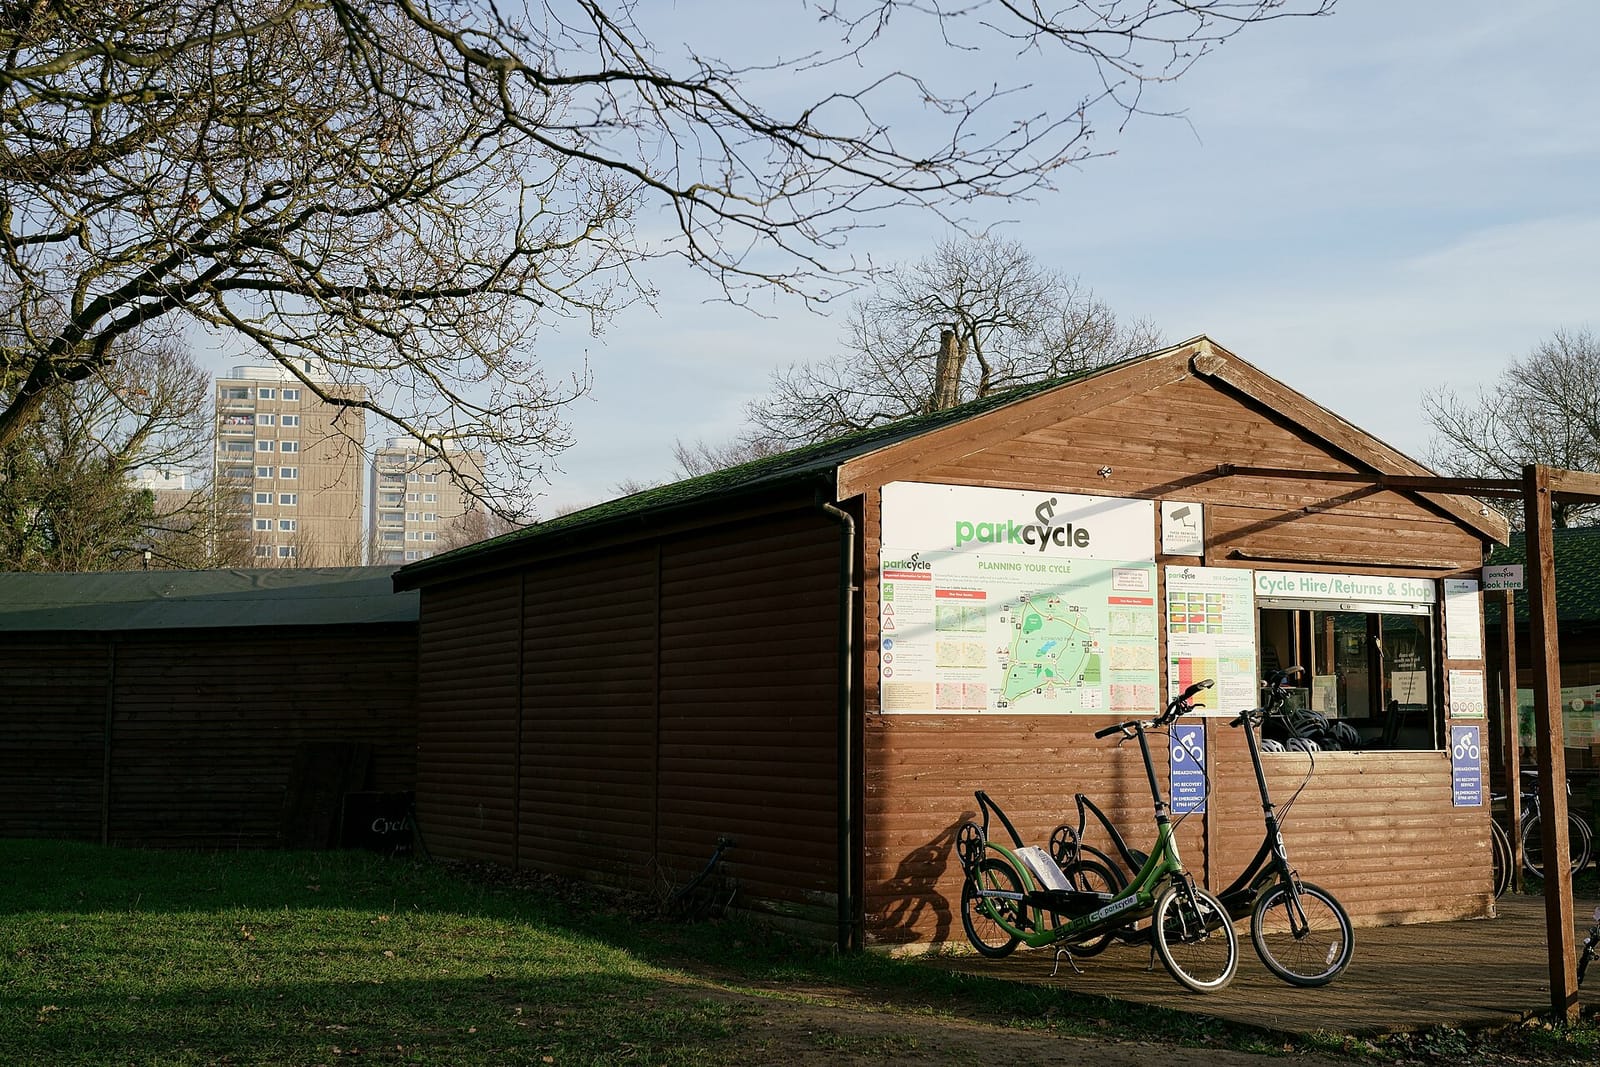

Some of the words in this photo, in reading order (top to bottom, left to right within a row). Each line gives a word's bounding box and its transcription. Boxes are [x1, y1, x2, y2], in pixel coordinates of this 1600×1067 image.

[955, 519, 1090, 552] parkcycle
[883, 559, 931, 571] parkcycle
[978, 561, 1022, 572] PLANNING
[1024, 563, 1047, 573] YOUR
[1048, 565, 1071, 574] CYCLE
[1259, 575, 1295, 594] Cycle
[1299, 577, 1383, 596] Hire/Returns
[1387, 583, 1397, 596] &
[1401, 582, 1431, 602] Shop
[1503, 580, 1522, 588] Here
[1103, 896, 1134, 916] parkcycle
